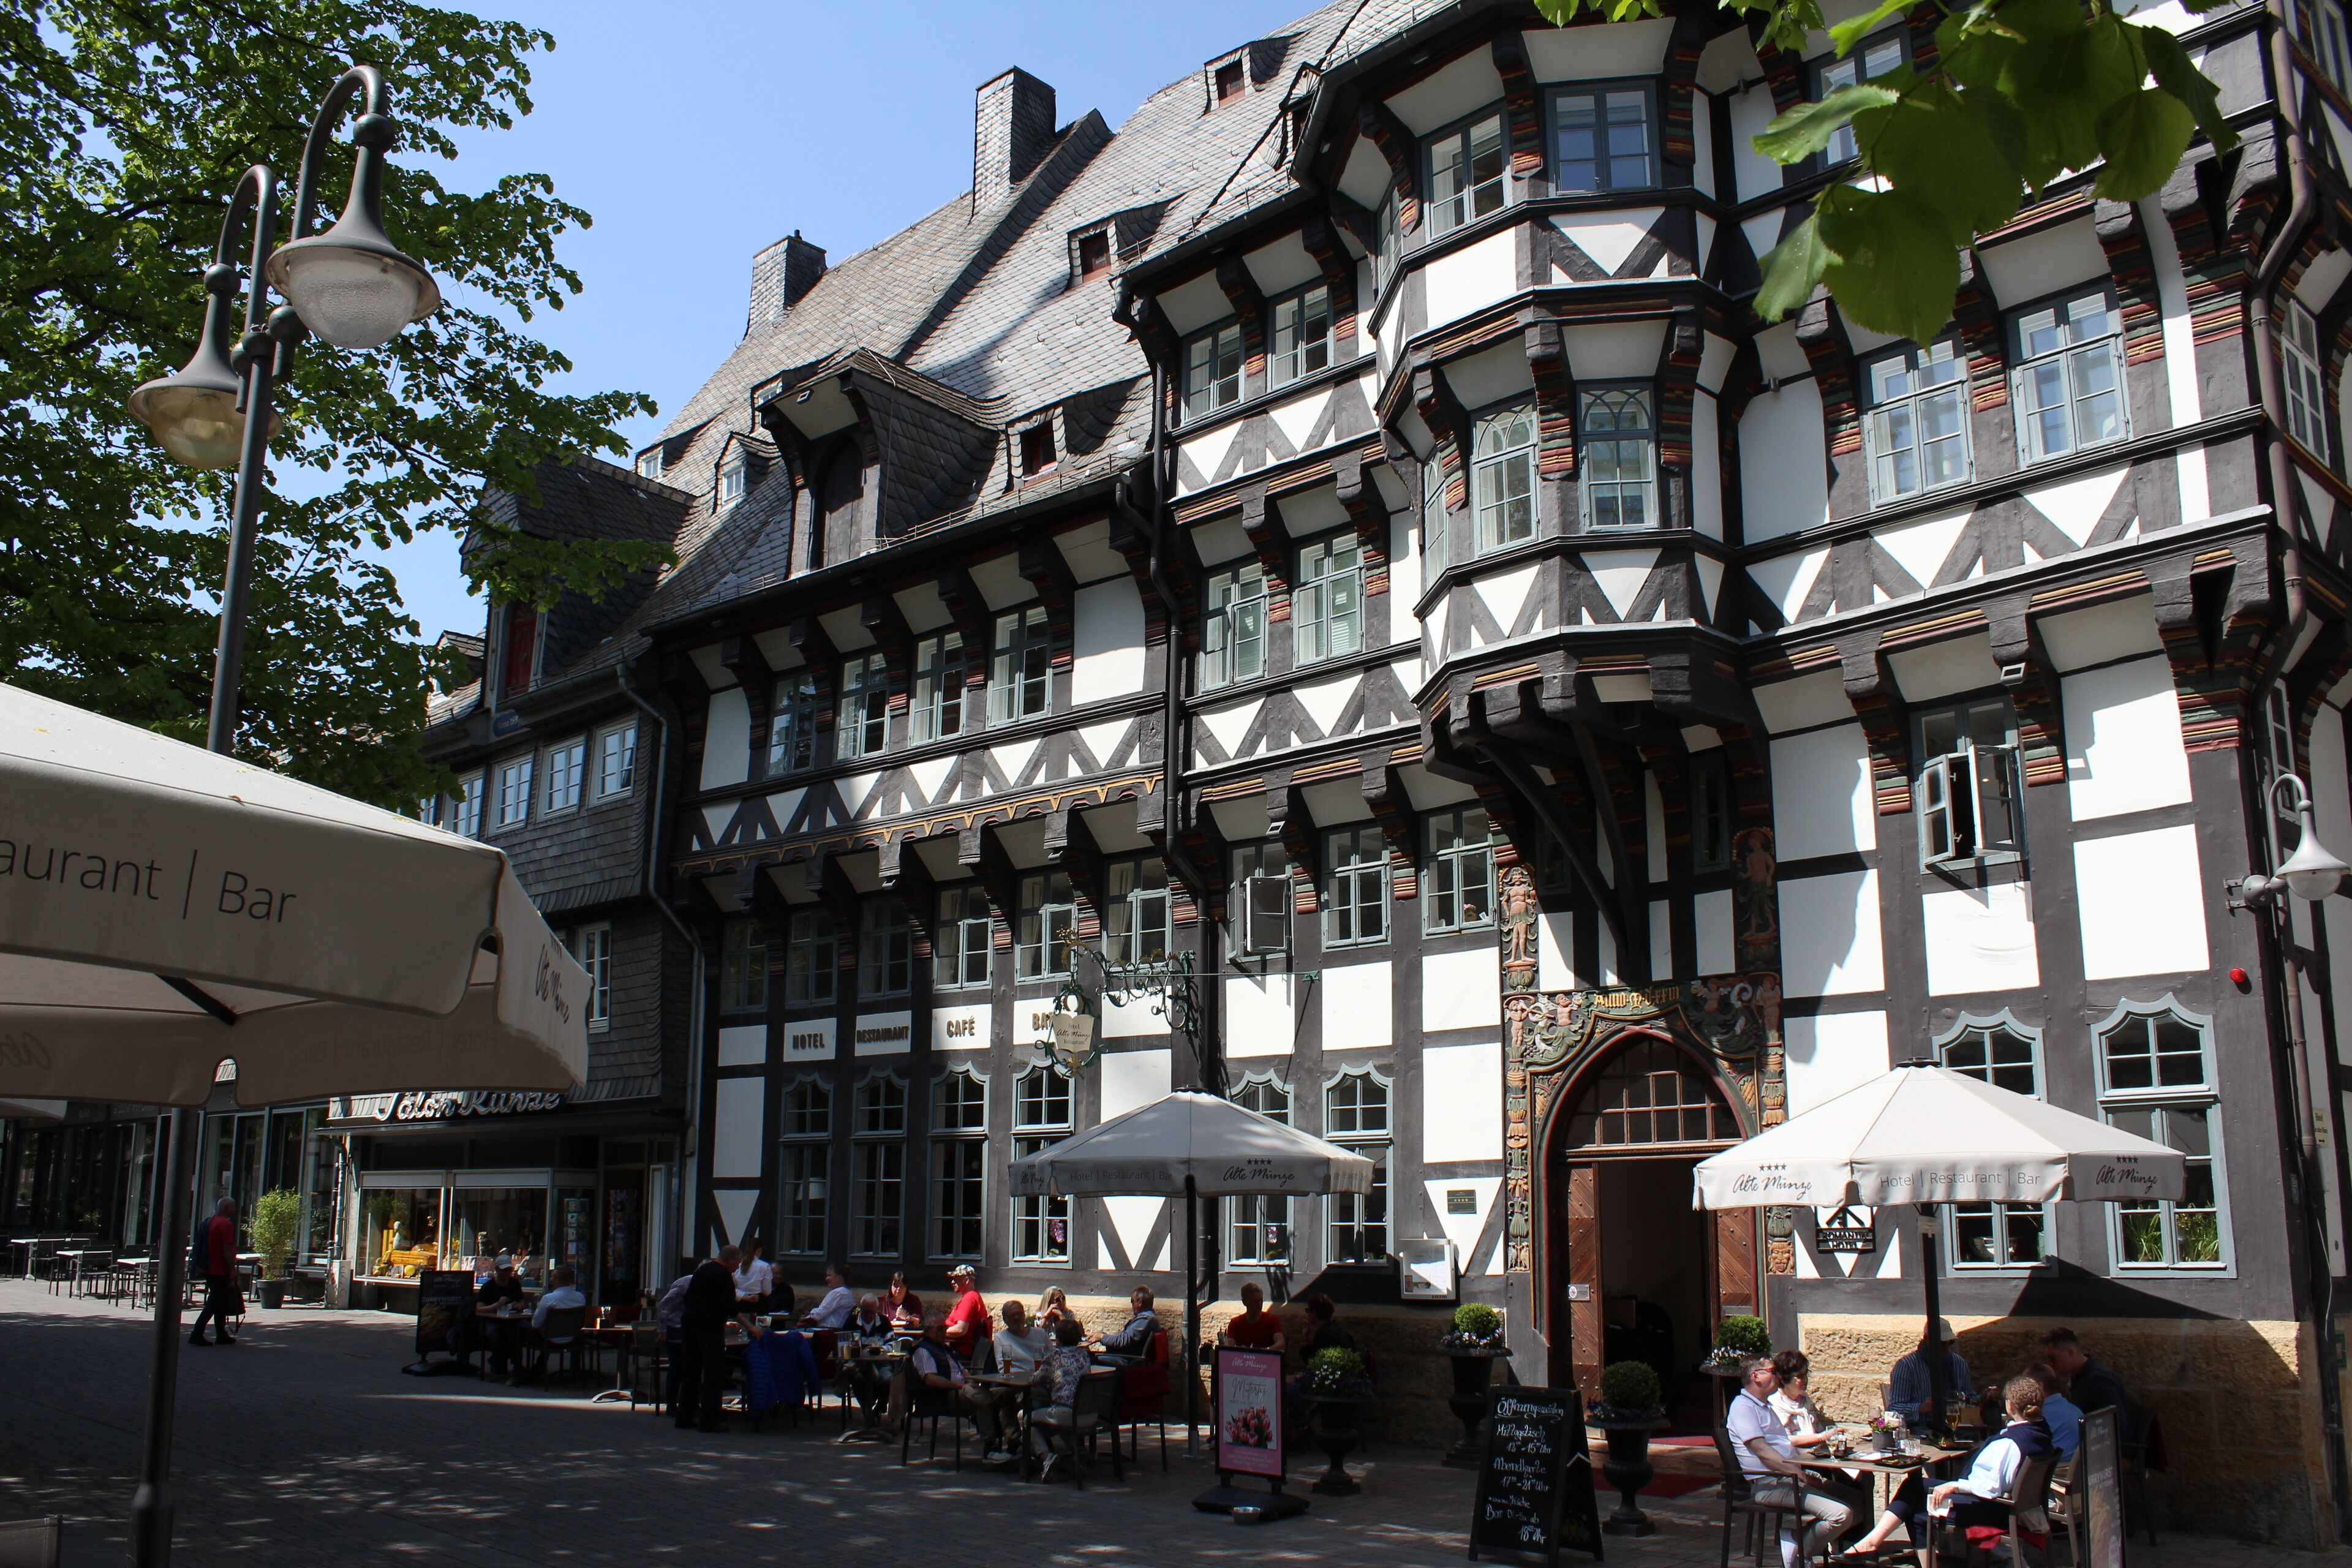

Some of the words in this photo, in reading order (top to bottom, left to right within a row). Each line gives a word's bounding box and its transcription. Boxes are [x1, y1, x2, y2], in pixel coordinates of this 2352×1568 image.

[217, 870, 297, 923] Bar
[856, 1025, 910, 1044] RESTAURANT
[946, 1016, 976, 1038] CAFÉ
[792, 1033, 825, 1050] HOTEL
[1070, 1170, 1093, 1182] Hotel
[1102, 1169, 1150, 1180] Restaurant
[1159, 1170, 1173, 1181] Bar
[1223, 1166, 1248, 1182] Alte
[1250, 1168, 1295, 1188] Münze
[1880, 1173, 1915, 1188] Hotel
[1929, 1171, 2002, 1184] Restaurant
[2017, 1172, 2041, 1185] Bar
[2095, 1164, 2116, 1185] Alte
[2117, 1168, 2158, 1194] Münze
[1732, 1174, 1759, 1193] Alte
[1761, 1175, 1813, 1200] Münze
[1231, 1357, 1244, 1366] Alte
[1231, 1378, 1268, 1404] Muttertag
[1497, 1397, 1564, 1418] Öffnungszeiten
[1496, 1423, 1546, 1443] Mittagstisch
[1539, 1444, 1551, 1454] Uhr
[1493, 1457, 1547, 1477] Abendkarte
[1535, 1480, 1551, 1492] Uhr
[1509, 1494, 1531, 1509] Küche
[1485, 1504, 1504, 1520] Bar
[1530, 1512, 1539, 1524] ab
[1532, 1528, 1547, 1545] Uhr
